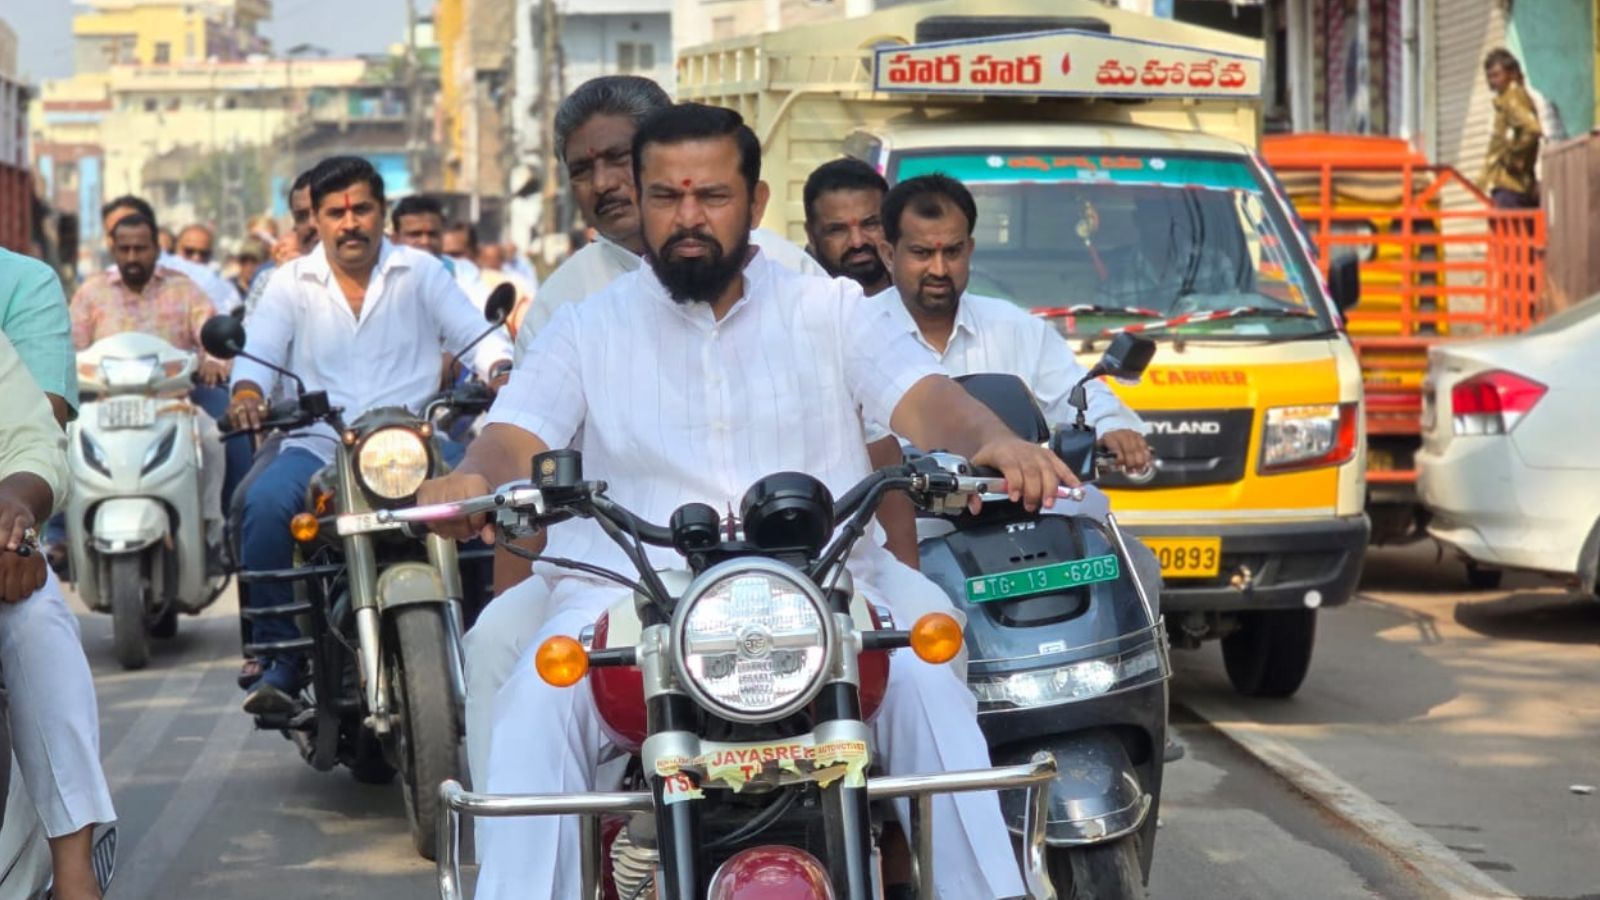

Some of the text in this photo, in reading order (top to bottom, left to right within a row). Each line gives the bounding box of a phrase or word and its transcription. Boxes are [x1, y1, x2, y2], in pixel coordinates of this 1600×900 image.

[889, 54, 1246, 89] హర హర మహాదేవ
[1149, 370, 1247, 386] CARRIER
[986, 558, 1115, 596] TG 13 6205
